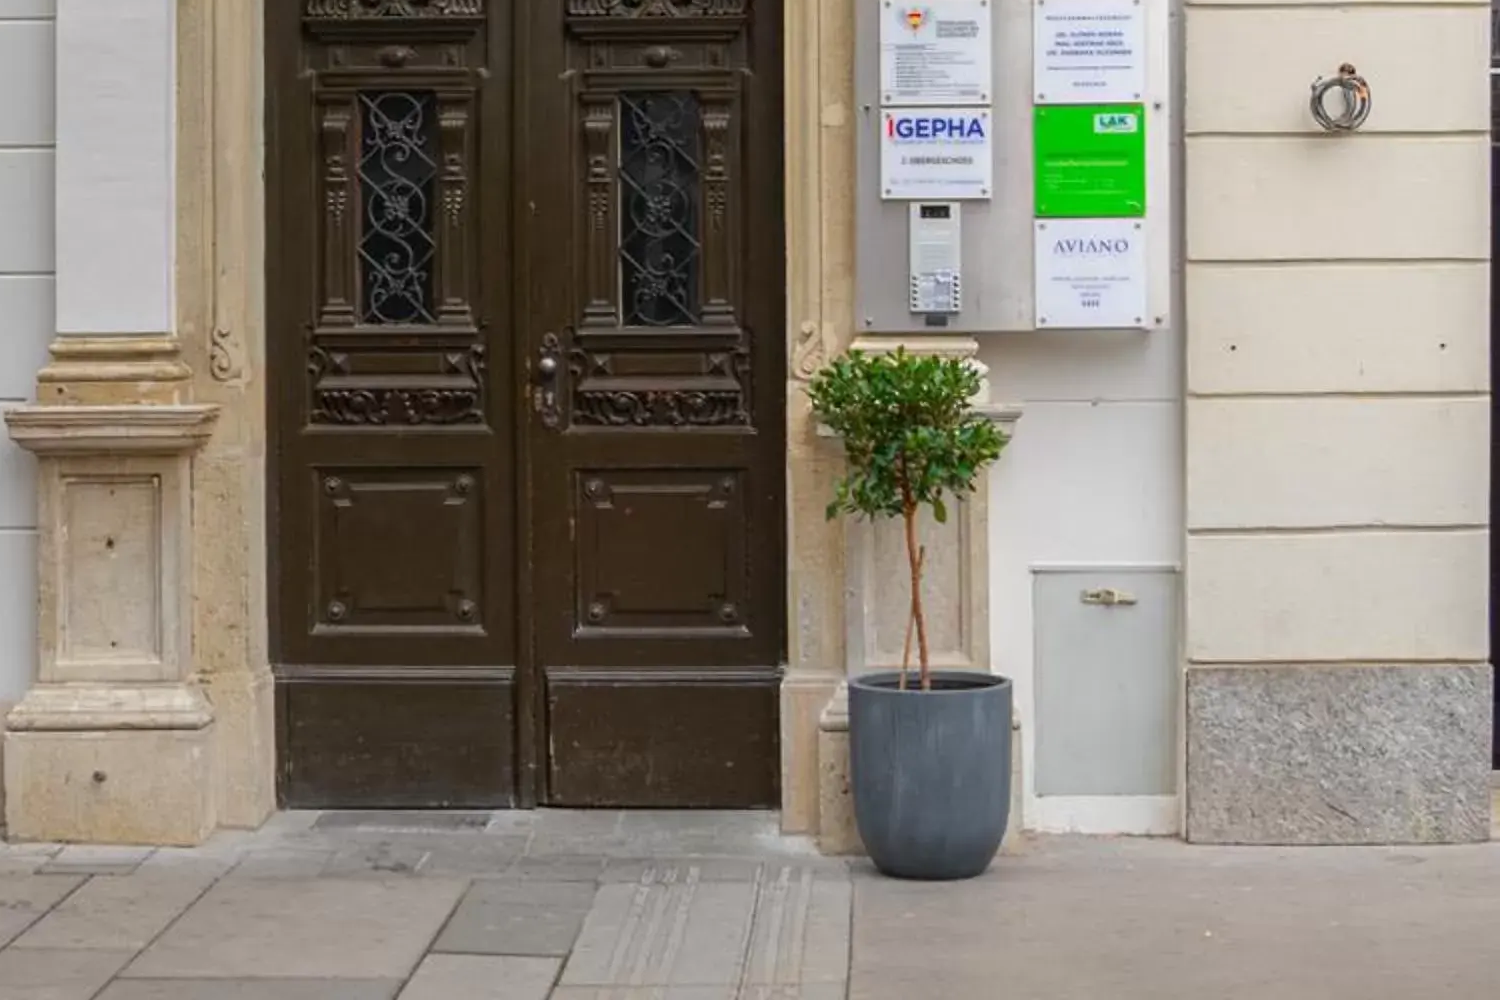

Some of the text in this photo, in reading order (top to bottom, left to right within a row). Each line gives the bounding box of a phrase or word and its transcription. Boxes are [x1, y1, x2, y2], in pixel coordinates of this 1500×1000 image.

[888, 117, 985, 138] IGEPHA
[1099, 115, 1128, 126] LAK
[1053, 239, 1129, 254] AVIANO
